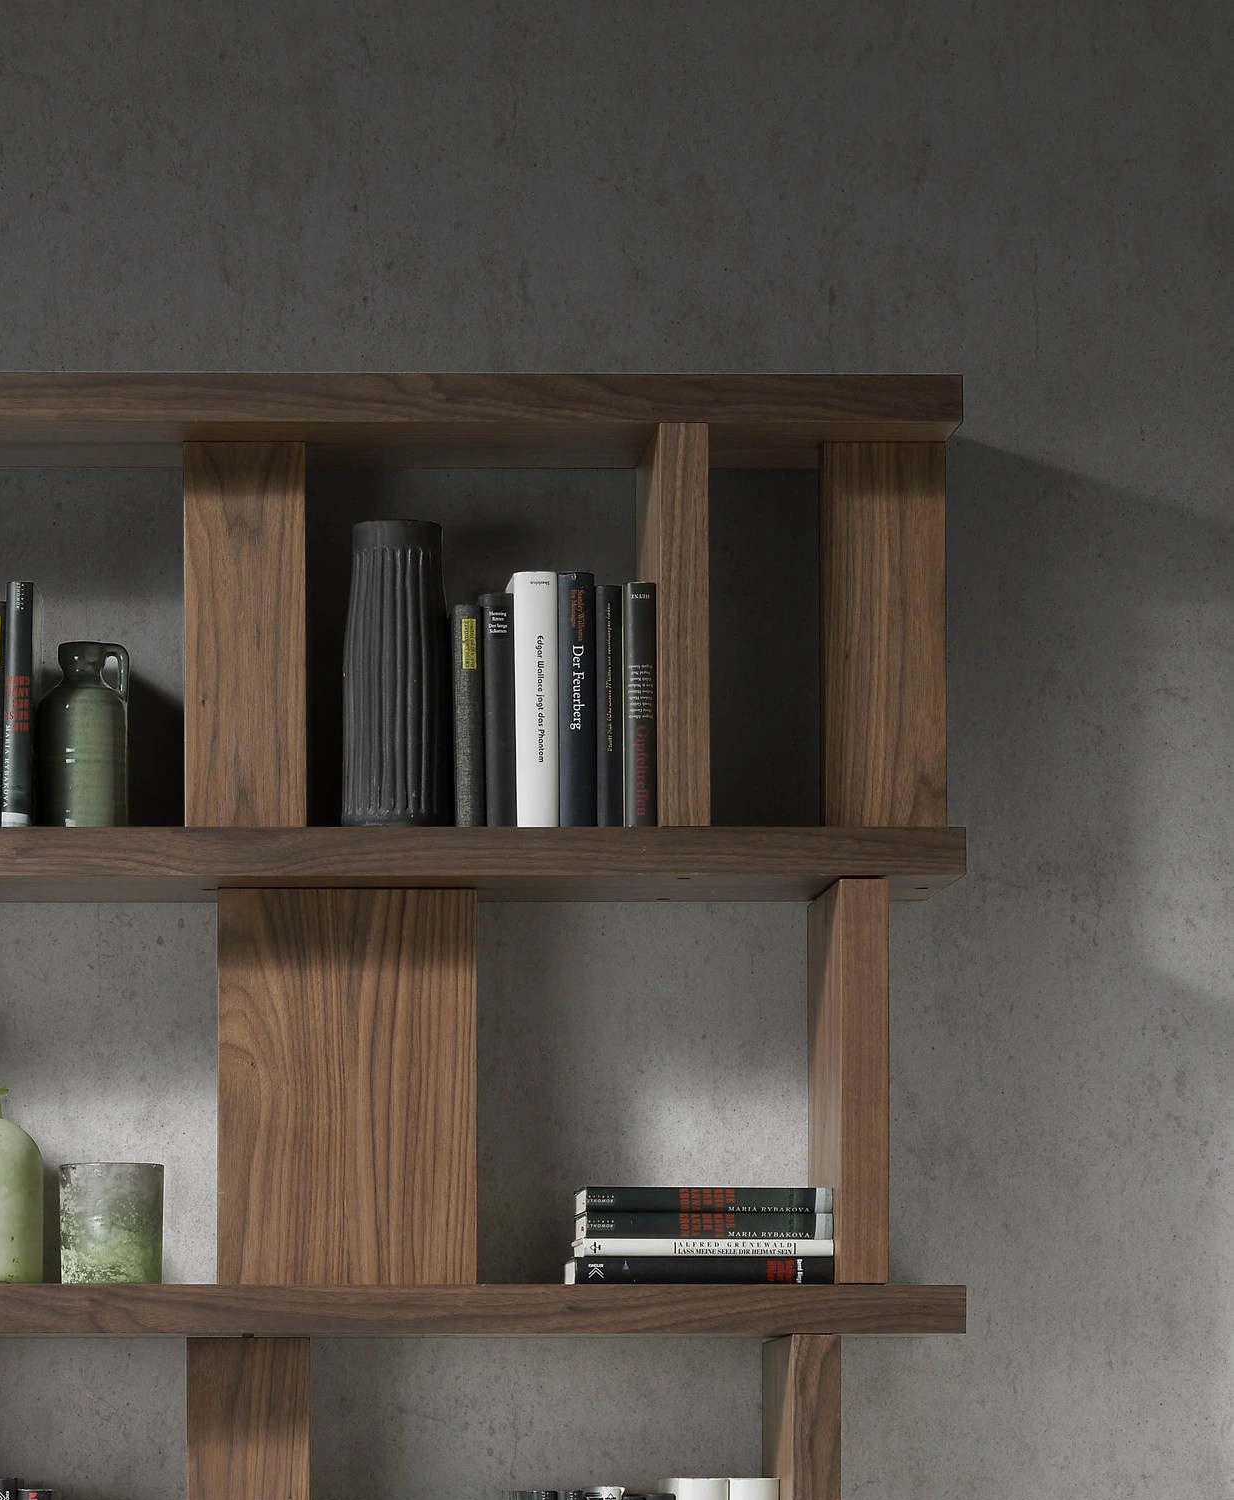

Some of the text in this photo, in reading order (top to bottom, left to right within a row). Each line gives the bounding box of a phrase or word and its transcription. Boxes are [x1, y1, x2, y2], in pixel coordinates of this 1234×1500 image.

[535, 635, 546, 763] Edgar Wallace jagt das Phantom
[570, 644, 585, 731] Der Feuerberg
[632, 725, 649, 816] Gipfeltreffen
